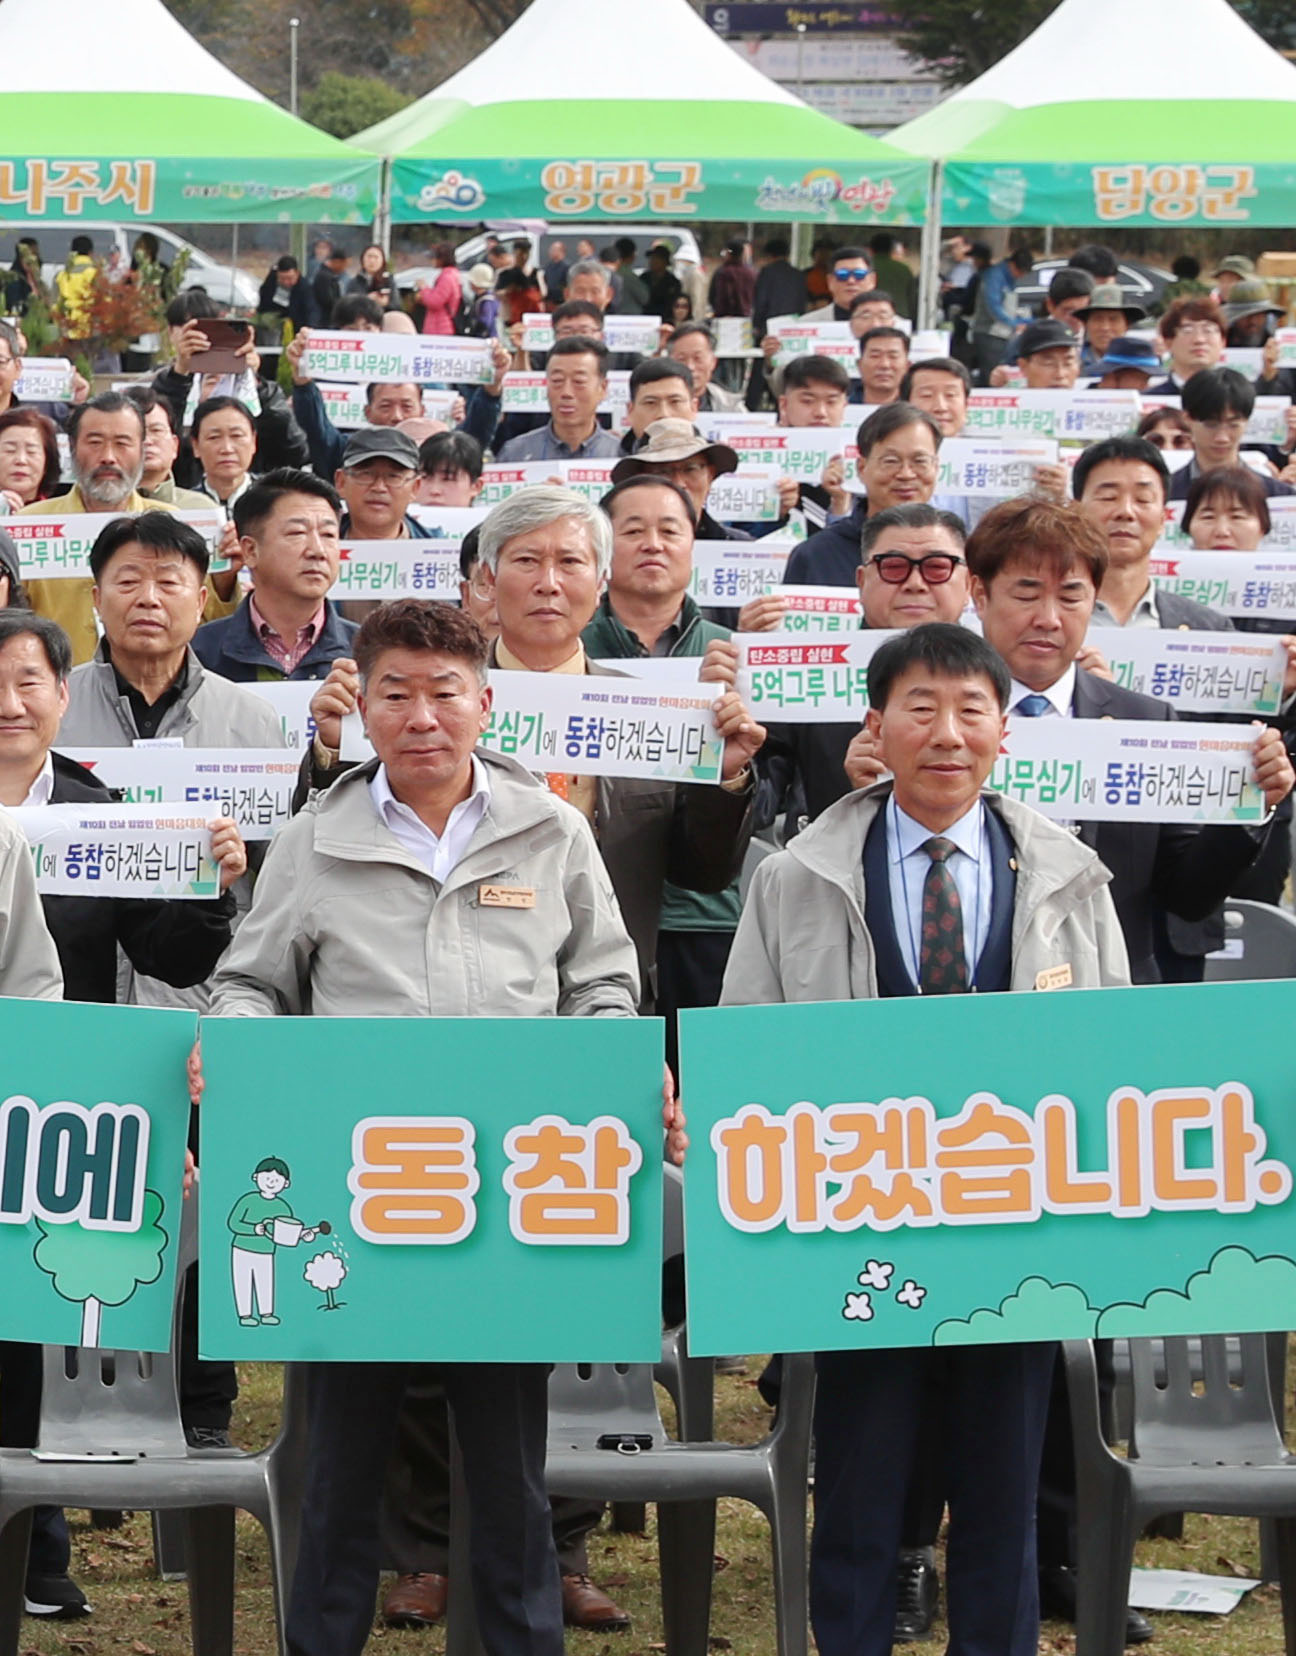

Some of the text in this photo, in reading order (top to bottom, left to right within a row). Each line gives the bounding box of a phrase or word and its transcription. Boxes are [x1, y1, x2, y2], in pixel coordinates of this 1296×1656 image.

[541, 160, 705, 214] 영광군
[1092, 164, 1258, 221] 담양군
[780, 450, 829, 477] 나무심기
[708, 485, 769, 512] 하겠습니다
[338, 560, 407, 590] 나무심기에
[712, 568, 782, 596] 동참하겠
[749, 646, 834, 664] 탄소중립 실현
[751, 668, 826, 708] 5억그루
[1150, 664, 1270, 702] 동참하겠습니다
[479, 710, 707, 768] 무심기에 동참하겠습니다
[989, 757, 1248, 807] 나무심기에 동참하겠습니다
[64, 843, 205, 883] 동참하겠습니다
[710, 1081, 1294, 1233] 하겠습니다.
[348, 1115, 642, 1246] 동참
